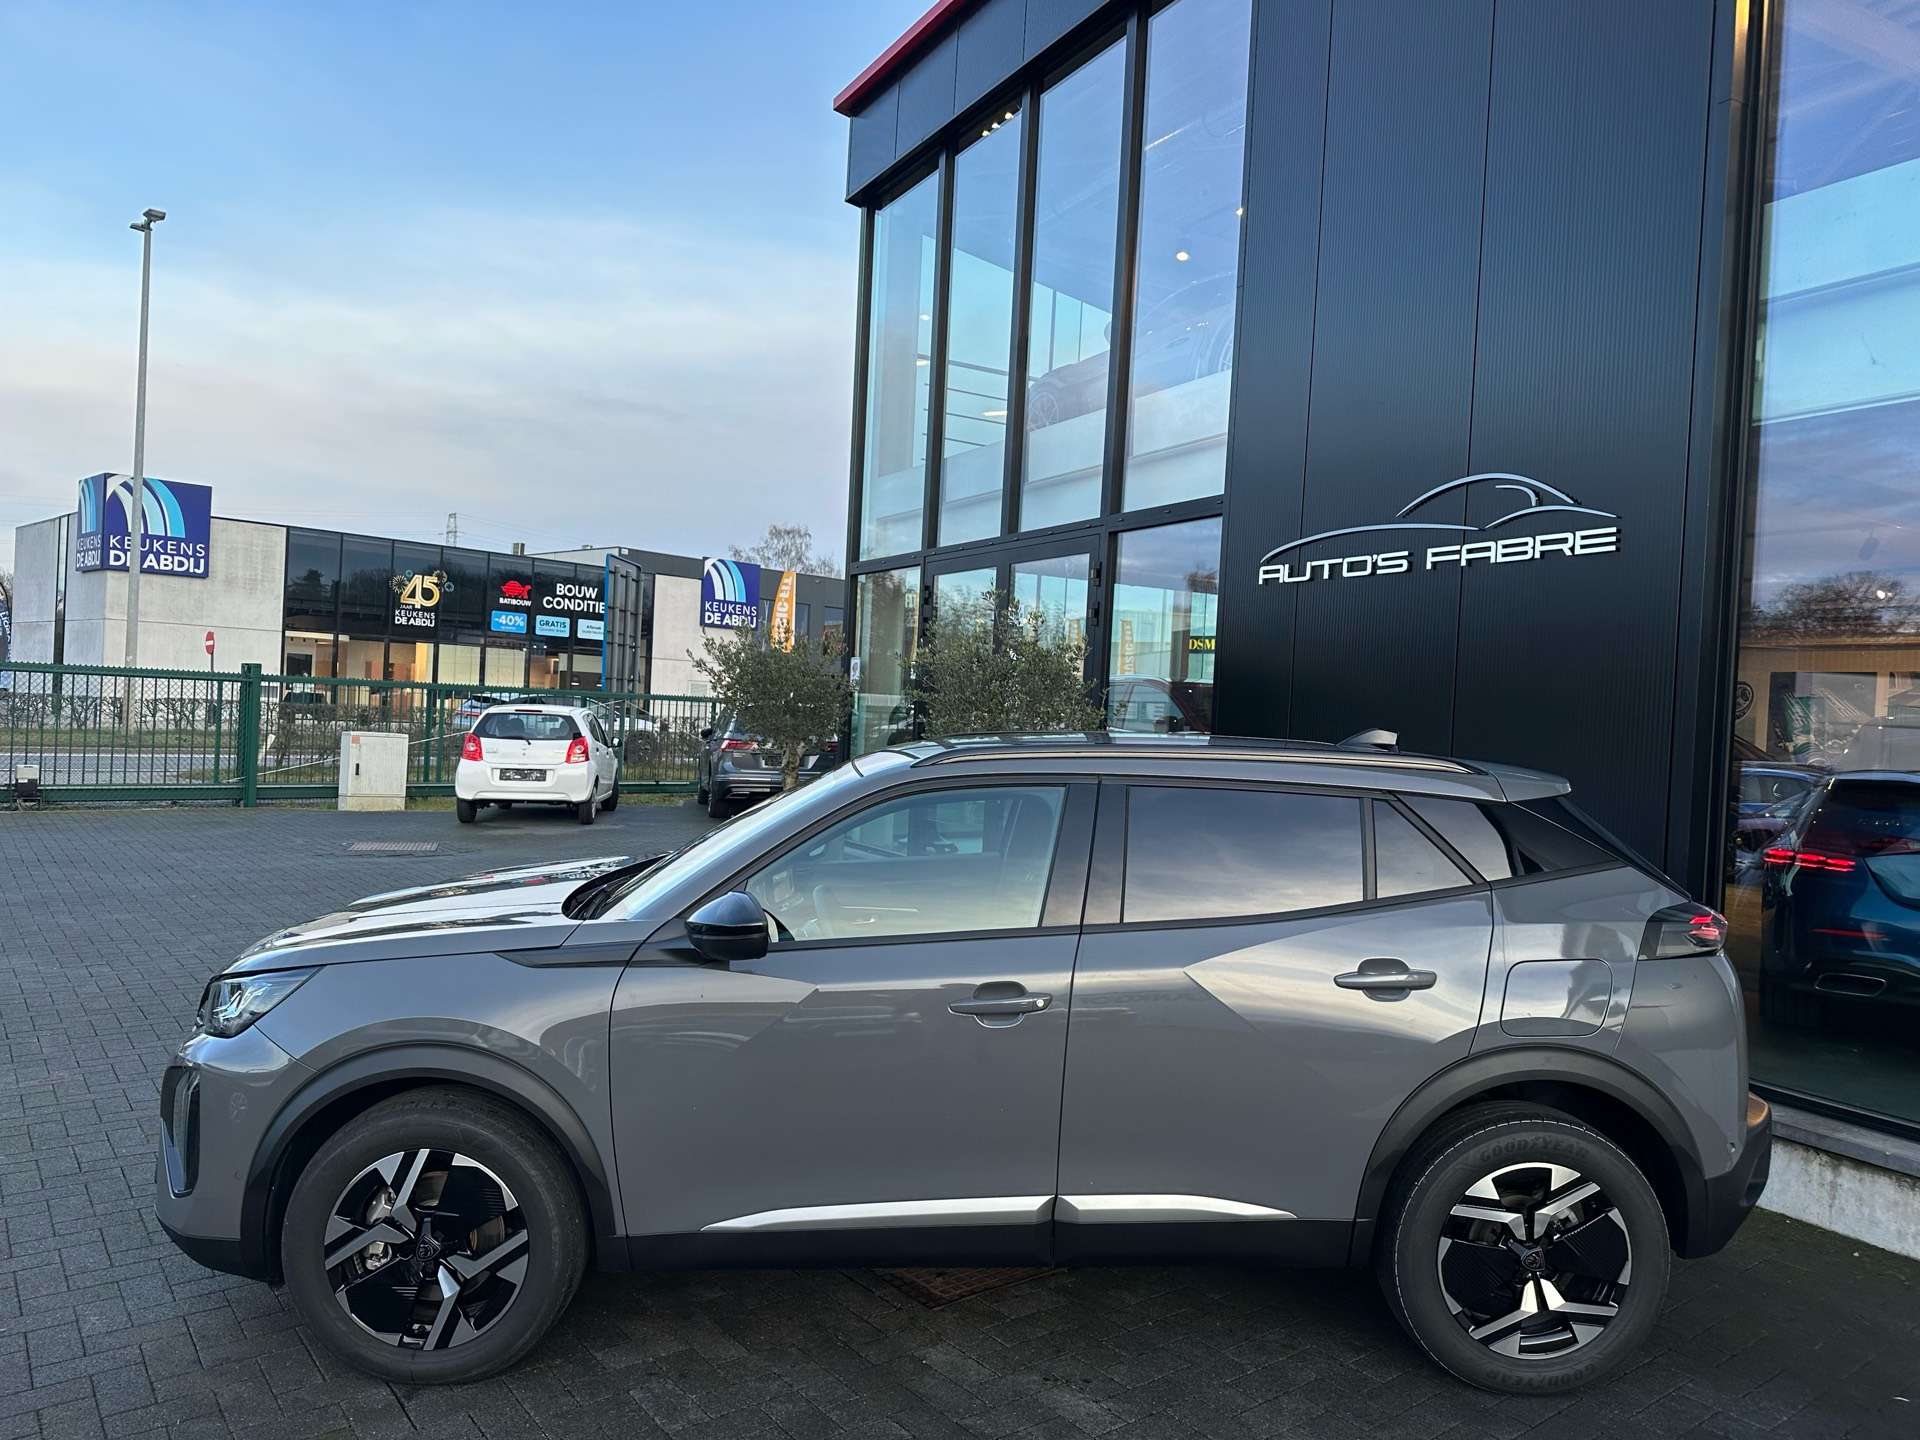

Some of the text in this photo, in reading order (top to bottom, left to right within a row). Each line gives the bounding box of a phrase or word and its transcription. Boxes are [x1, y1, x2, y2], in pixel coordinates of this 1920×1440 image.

[1258, 526, 1618, 585] AUTO'S FABRE
[142, 553, 205, 574] ABDIJ
[400, 574, 440, 609] 45
[556, 583, 598, 599] BOUW
[499, 597, 532, 607] BATIBOUW
[705, 600, 757, 616] KEUKENS
[394, 609, 436, 620] KEUKENS
[394, 616, 408, 625] DE
[493, 615, 524, 627] -40%
[705, 611, 721, 624] DE
[539, 619, 567, 629] GRATIS
[1188, 638, 1216, 651] DSM
[1479, 1135, 1590, 1162] GOODYEAR
